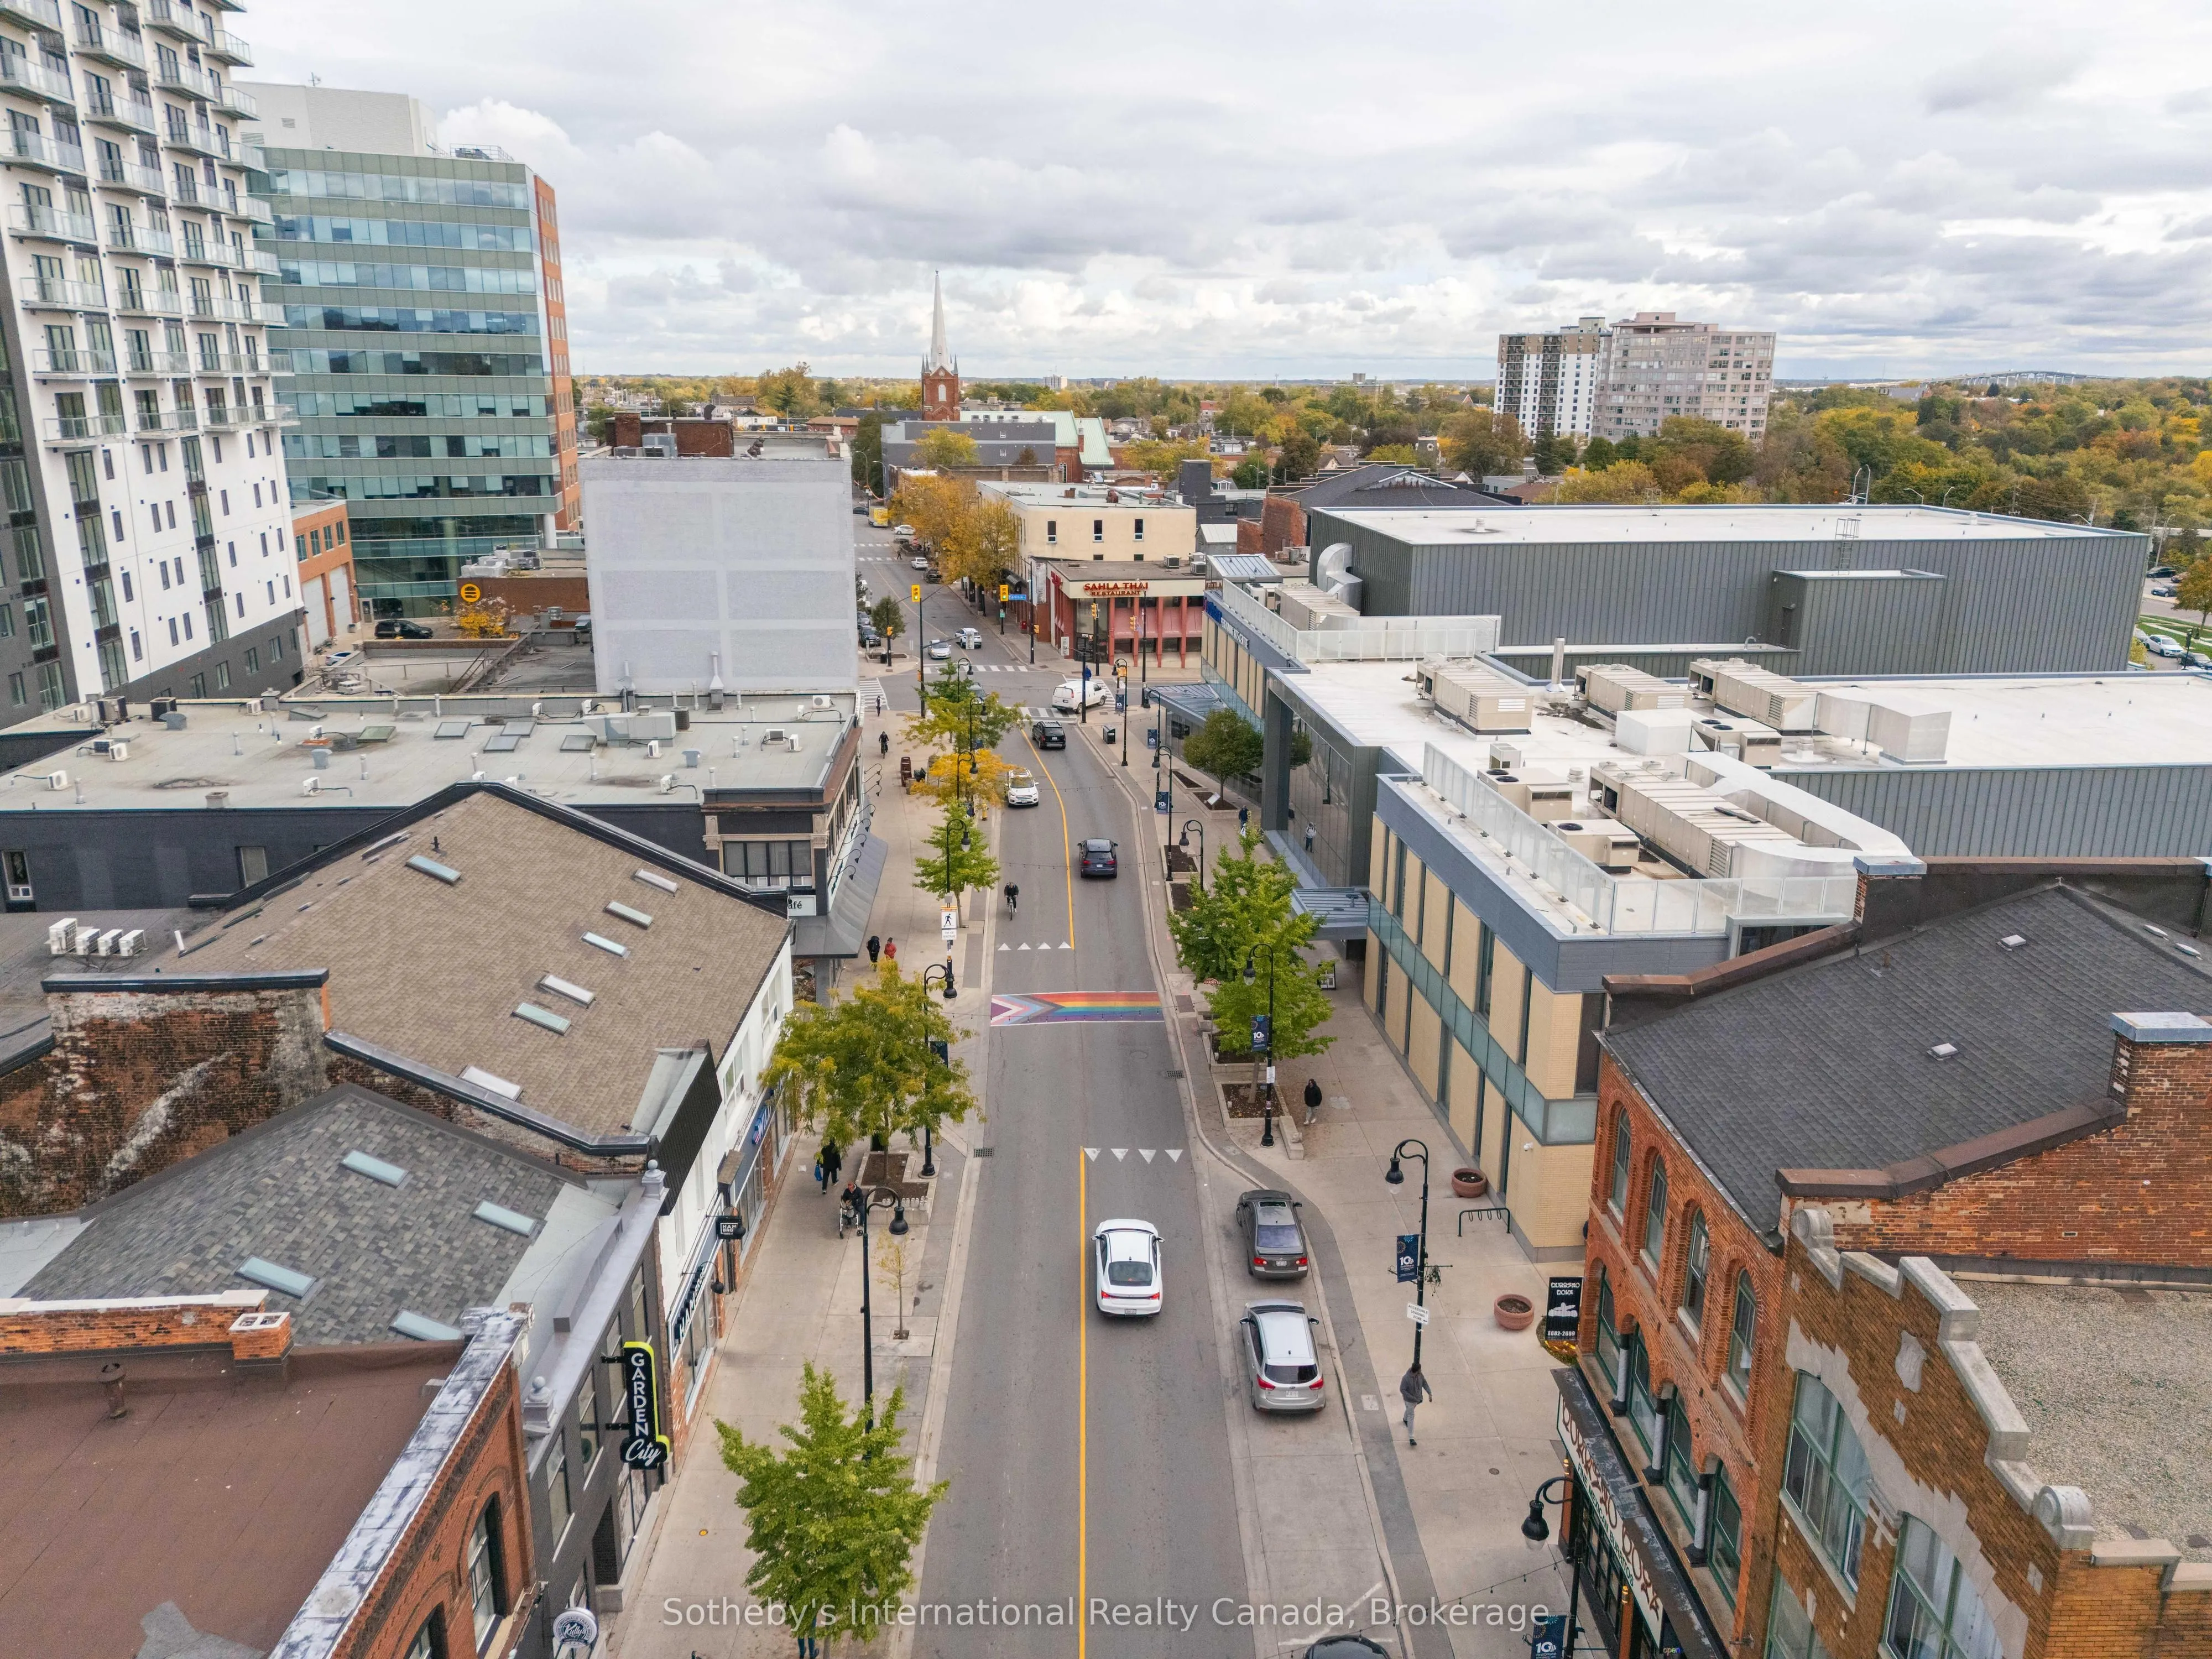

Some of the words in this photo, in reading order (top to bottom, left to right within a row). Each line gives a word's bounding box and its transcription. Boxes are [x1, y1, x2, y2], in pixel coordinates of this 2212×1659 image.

[788, 901, 802, 909] afé
[631, 1353, 649, 1437] GARDEN
[625, 1439, 661, 1467] City
[1578, 1463, 1588, 1489] FINE
[1588, 1485, 1609, 1533] MEXICAN
[1609, 1530, 1634, 1587] BURRITOS
[1663, 1648, 1680, 1656] open
